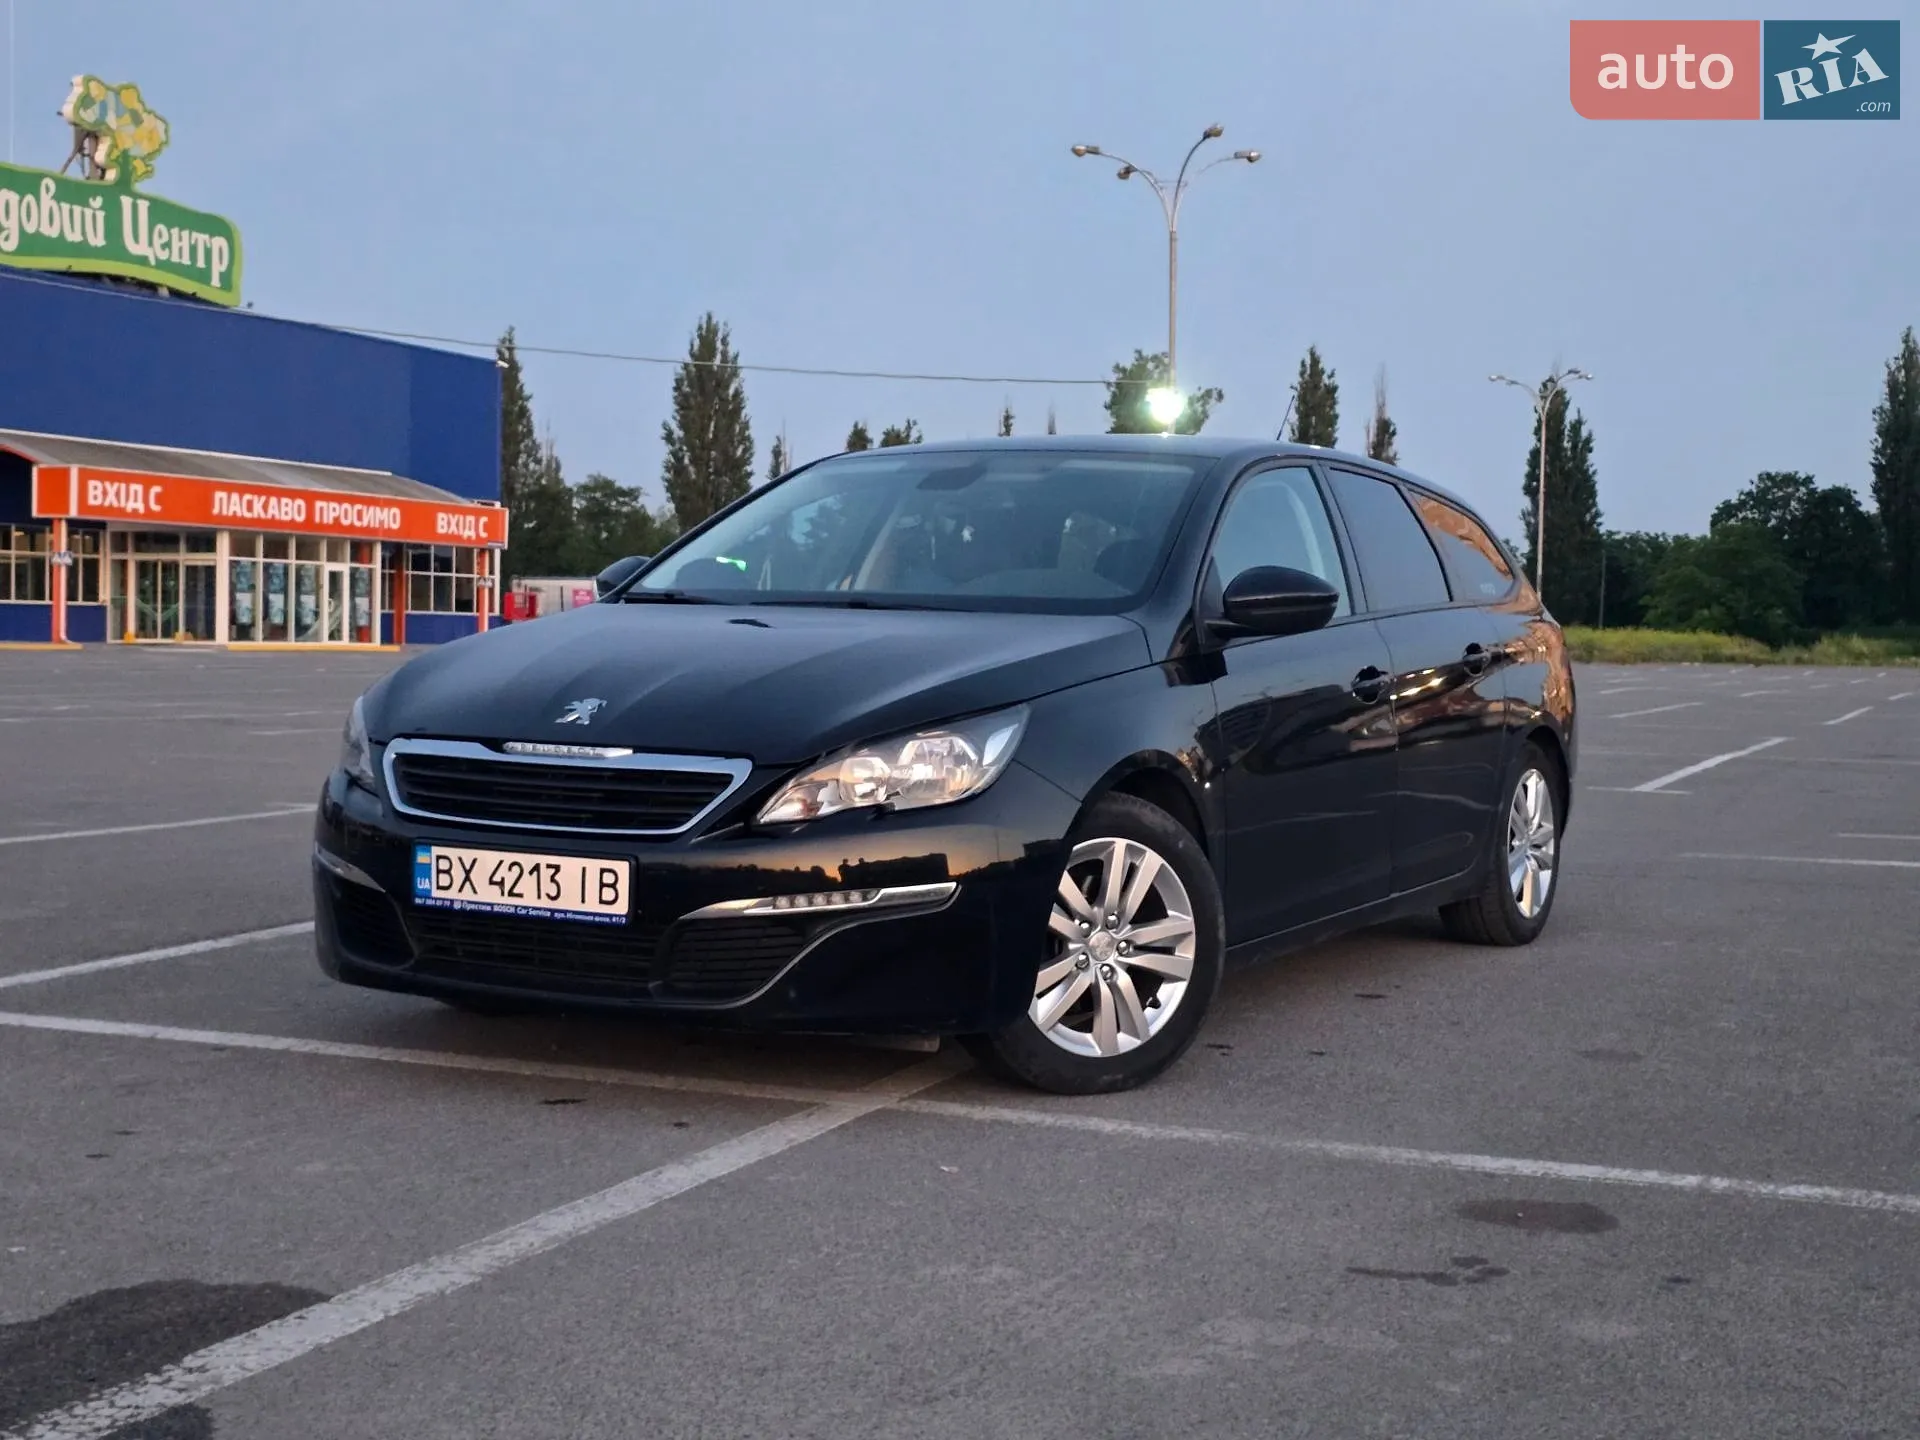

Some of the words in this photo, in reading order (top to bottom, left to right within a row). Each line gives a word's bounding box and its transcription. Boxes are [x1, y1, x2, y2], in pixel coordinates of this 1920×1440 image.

[120, 195, 229, 288] Центр
[87, 479, 145, 514] ВХІД
[212, 490, 307, 522] ЛАСКАВО
[315, 500, 401, 530] ПРОСИМО
[436, 512, 476, 540] ВХІД
[417, 876, 431, 889] UA
[435, 854, 478, 895] BX
[488, 859, 562, 901] 4213
